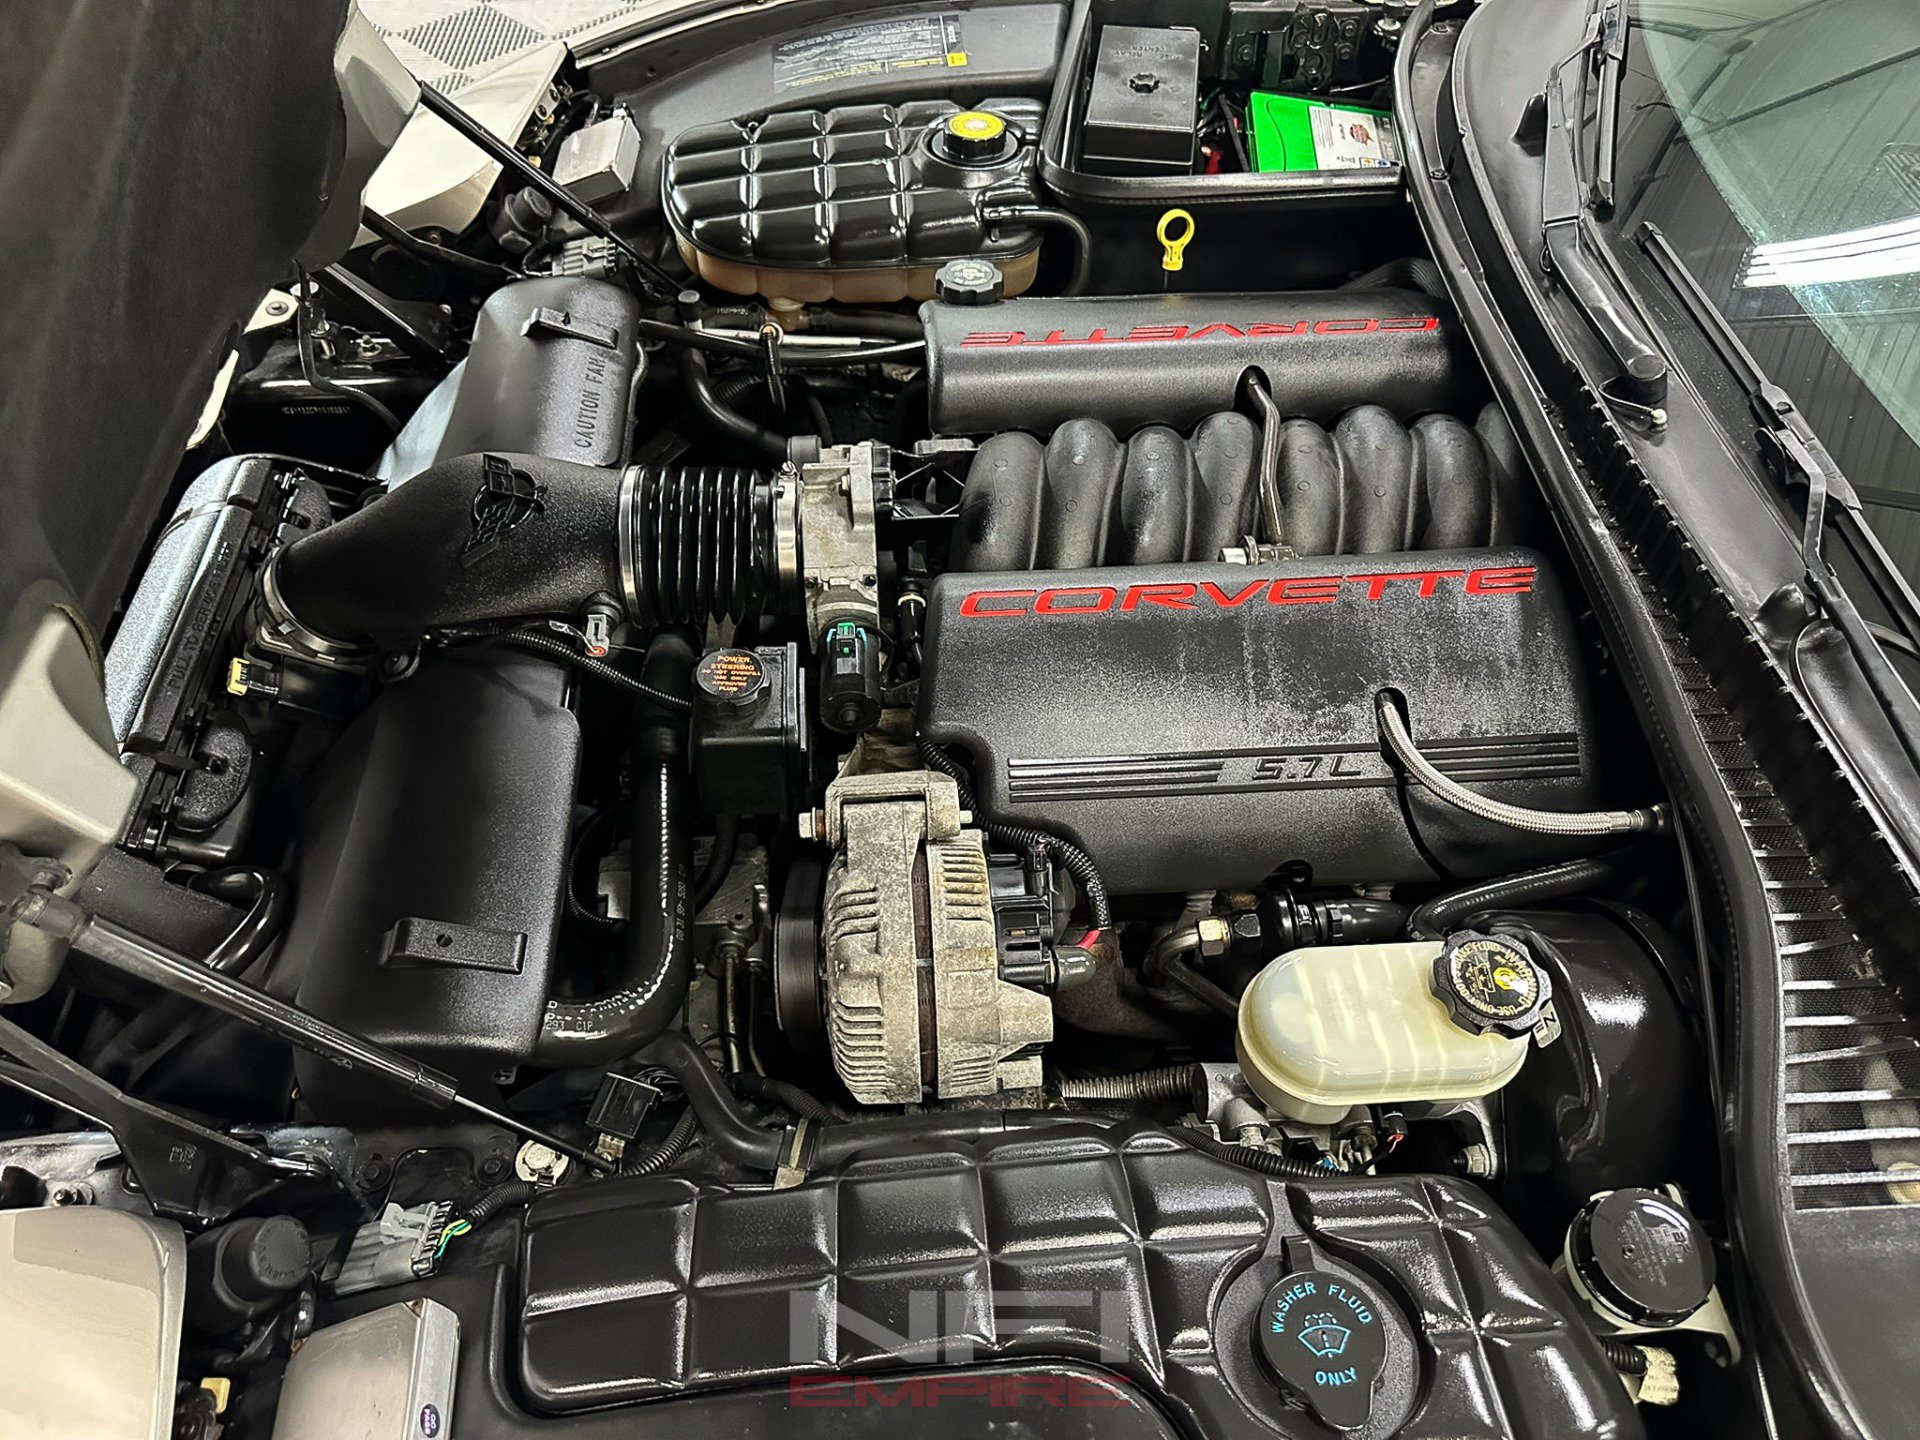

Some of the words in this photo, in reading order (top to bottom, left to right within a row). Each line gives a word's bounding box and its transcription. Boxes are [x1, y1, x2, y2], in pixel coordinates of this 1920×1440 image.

[960, 317, 1439, 348] CORVETTE
[585, 355, 606, 384] FAN
[574, 389, 601, 448] CAUTION
[960, 565, 1536, 617] CORVETTE
[1252, 756, 1362, 780] 5.7L
[1271, 1281, 1317, 1334] WASHER
[1327, 1283, 1374, 1324] FLUID
[1315, 1366, 1358, 1386] ONLY
